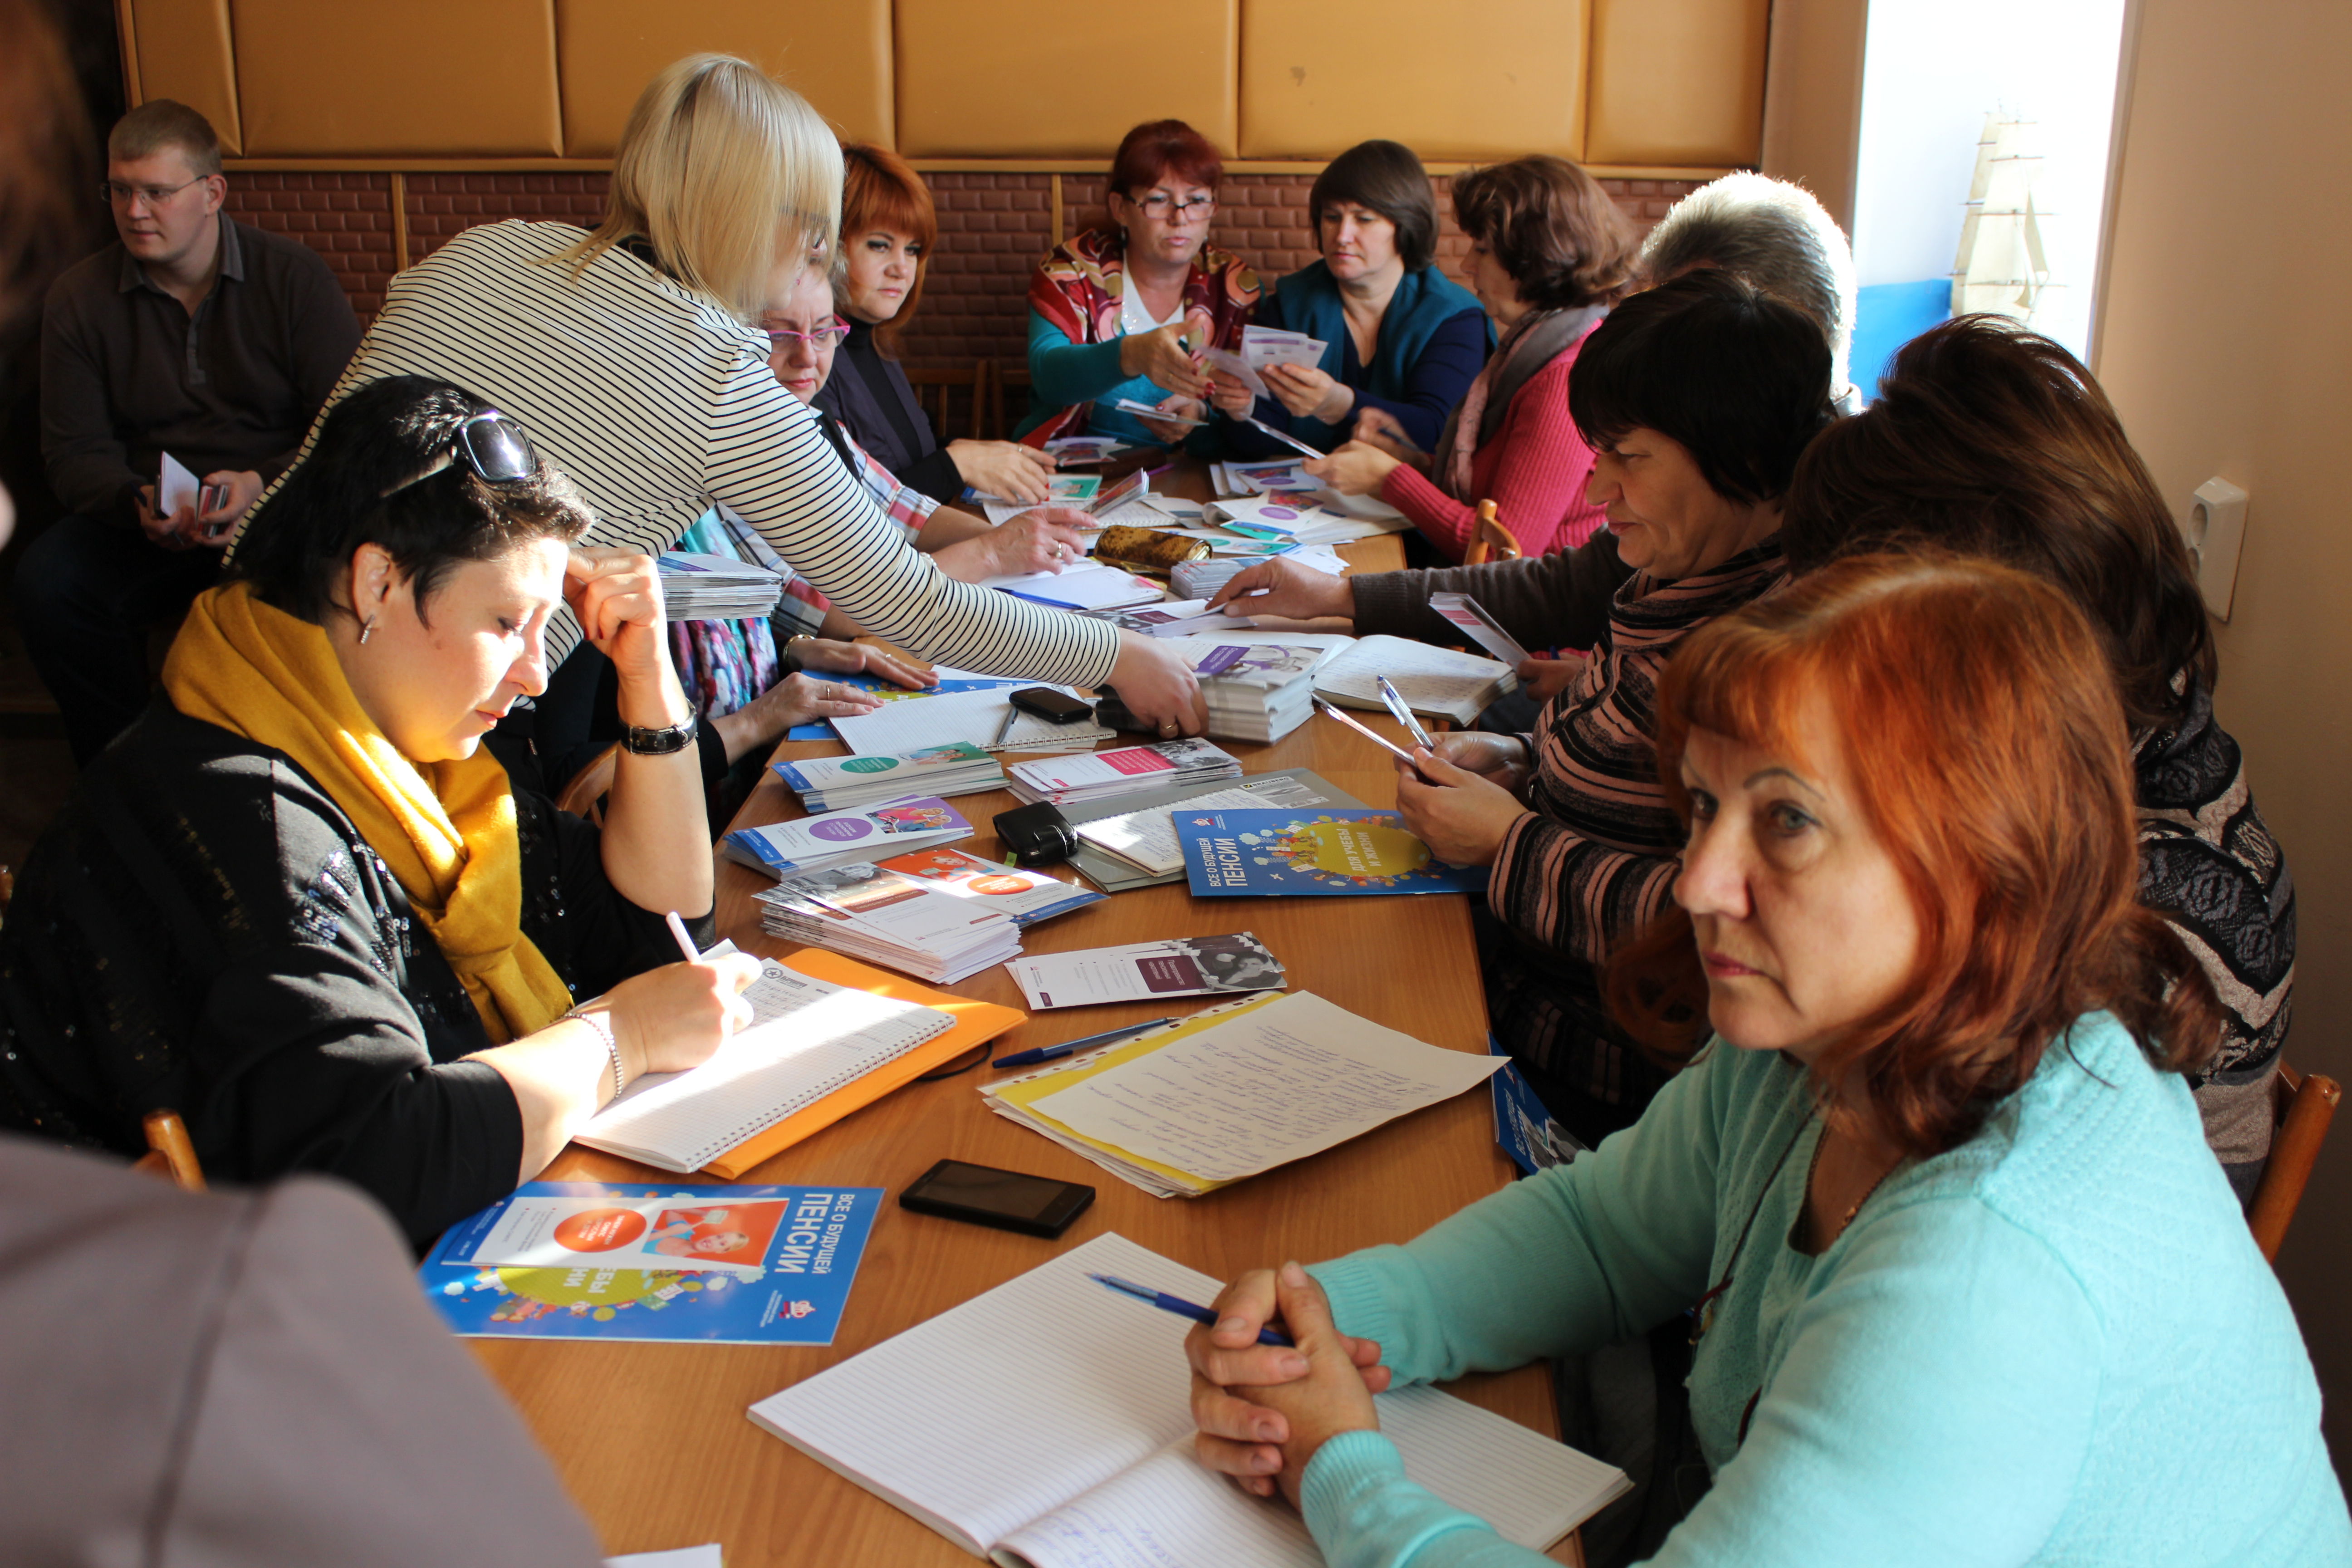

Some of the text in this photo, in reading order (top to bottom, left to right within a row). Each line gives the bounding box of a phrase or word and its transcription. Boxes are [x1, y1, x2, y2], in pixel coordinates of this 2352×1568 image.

[1252, 777, 1289, 787] BRAUBERG
[1196, 838, 1216, 867] БУДУЩЕЙ
[1214, 838, 1248, 887] ПЕНСИИ
[1336, 828, 1367, 872] ДЛЯ УЧЕБЫ
[1356, 832, 1379, 860] ЖИЗНИ
[1208, 873, 1222, 887] ВСЕ
[774, 1193, 833, 1273] ПЕНСИИ
[812, 1194, 855, 1274] ВСЕ О БУДУЩЕЙ
